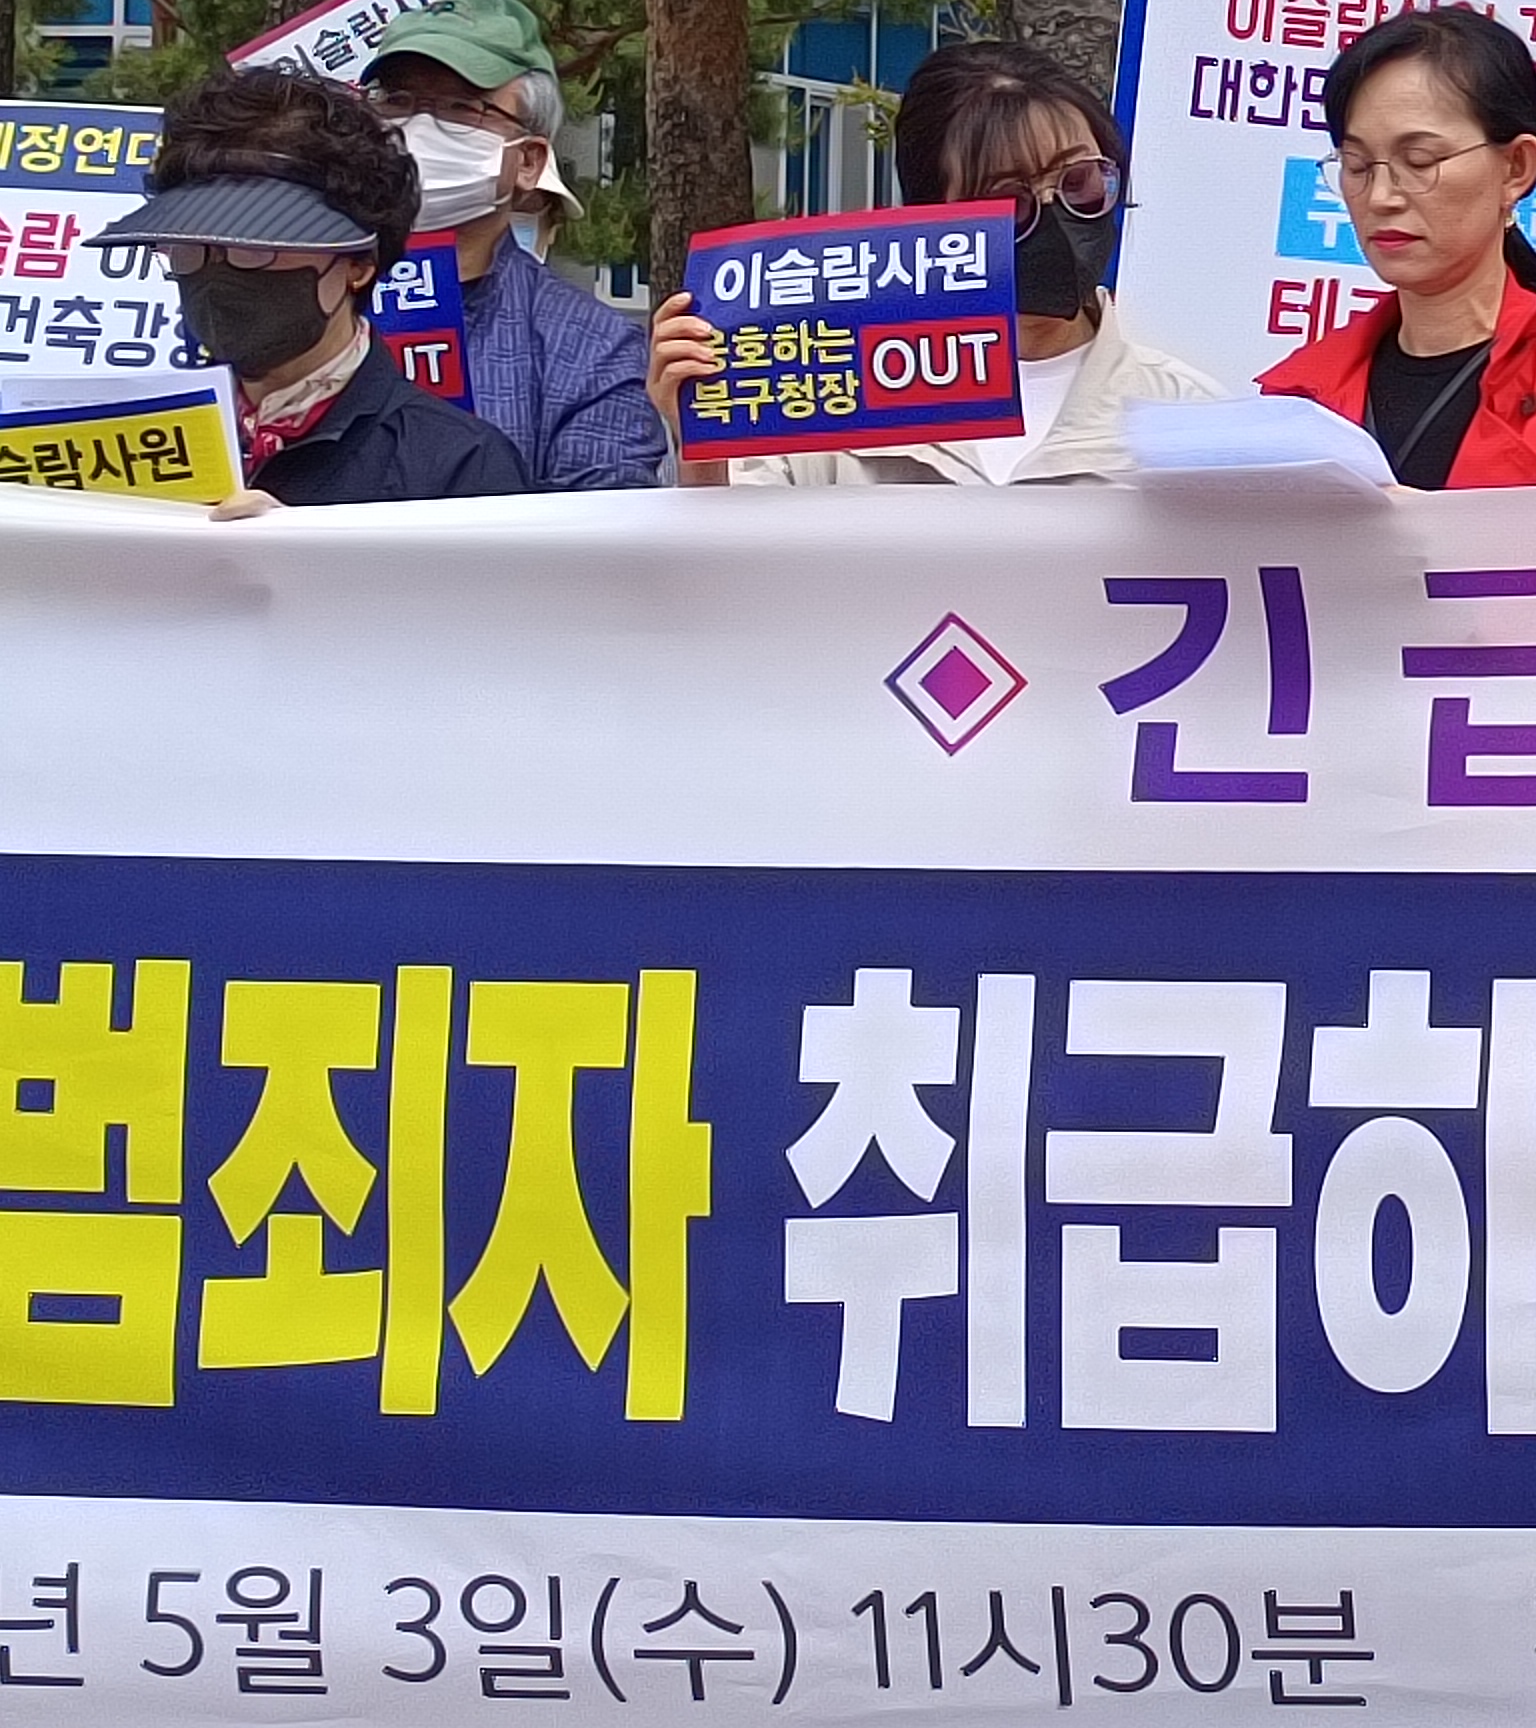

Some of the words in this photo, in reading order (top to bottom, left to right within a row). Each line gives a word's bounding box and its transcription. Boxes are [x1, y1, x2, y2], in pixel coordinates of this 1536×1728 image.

[713, 231, 988, 309] 이슬람사원
[690, 370, 860, 423] 북구청장
[872, 332, 999, 389] OUT
[0, 957, 712, 1422] 범죄자
[139, 1565, 329, 1697] 5월
[380, 1573, 800, 1705] 3일(수)
[850, 1584, 1376, 1709] 11시30분
